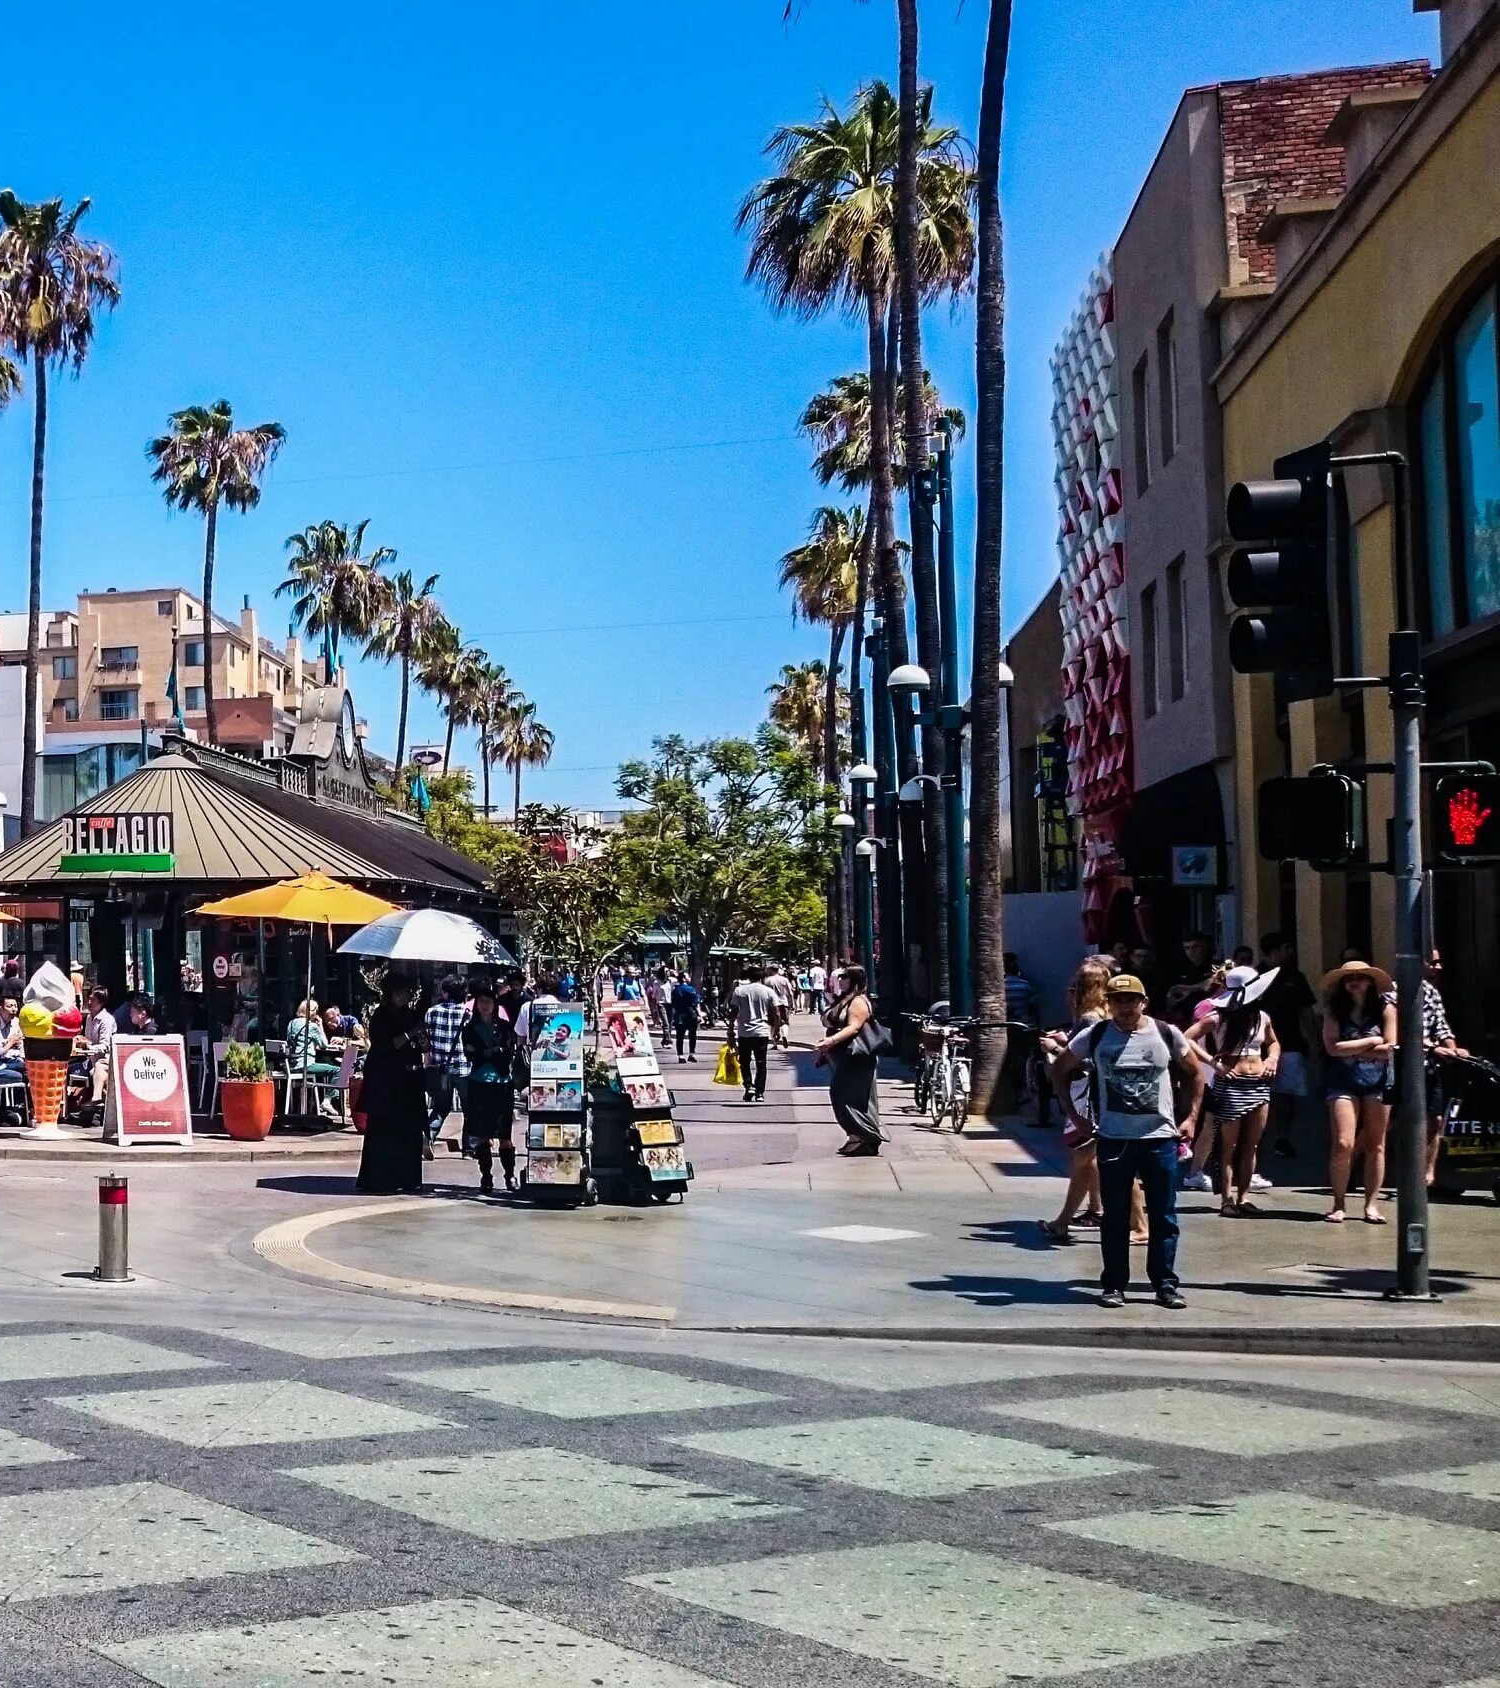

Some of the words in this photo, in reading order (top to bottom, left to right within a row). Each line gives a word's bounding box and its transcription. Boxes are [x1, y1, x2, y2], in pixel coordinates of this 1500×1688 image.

[61, 815, 171, 855] BELLAGIO
[142, 1056, 157, 1067] We
[133, 1069, 167, 1080] Deliver!
